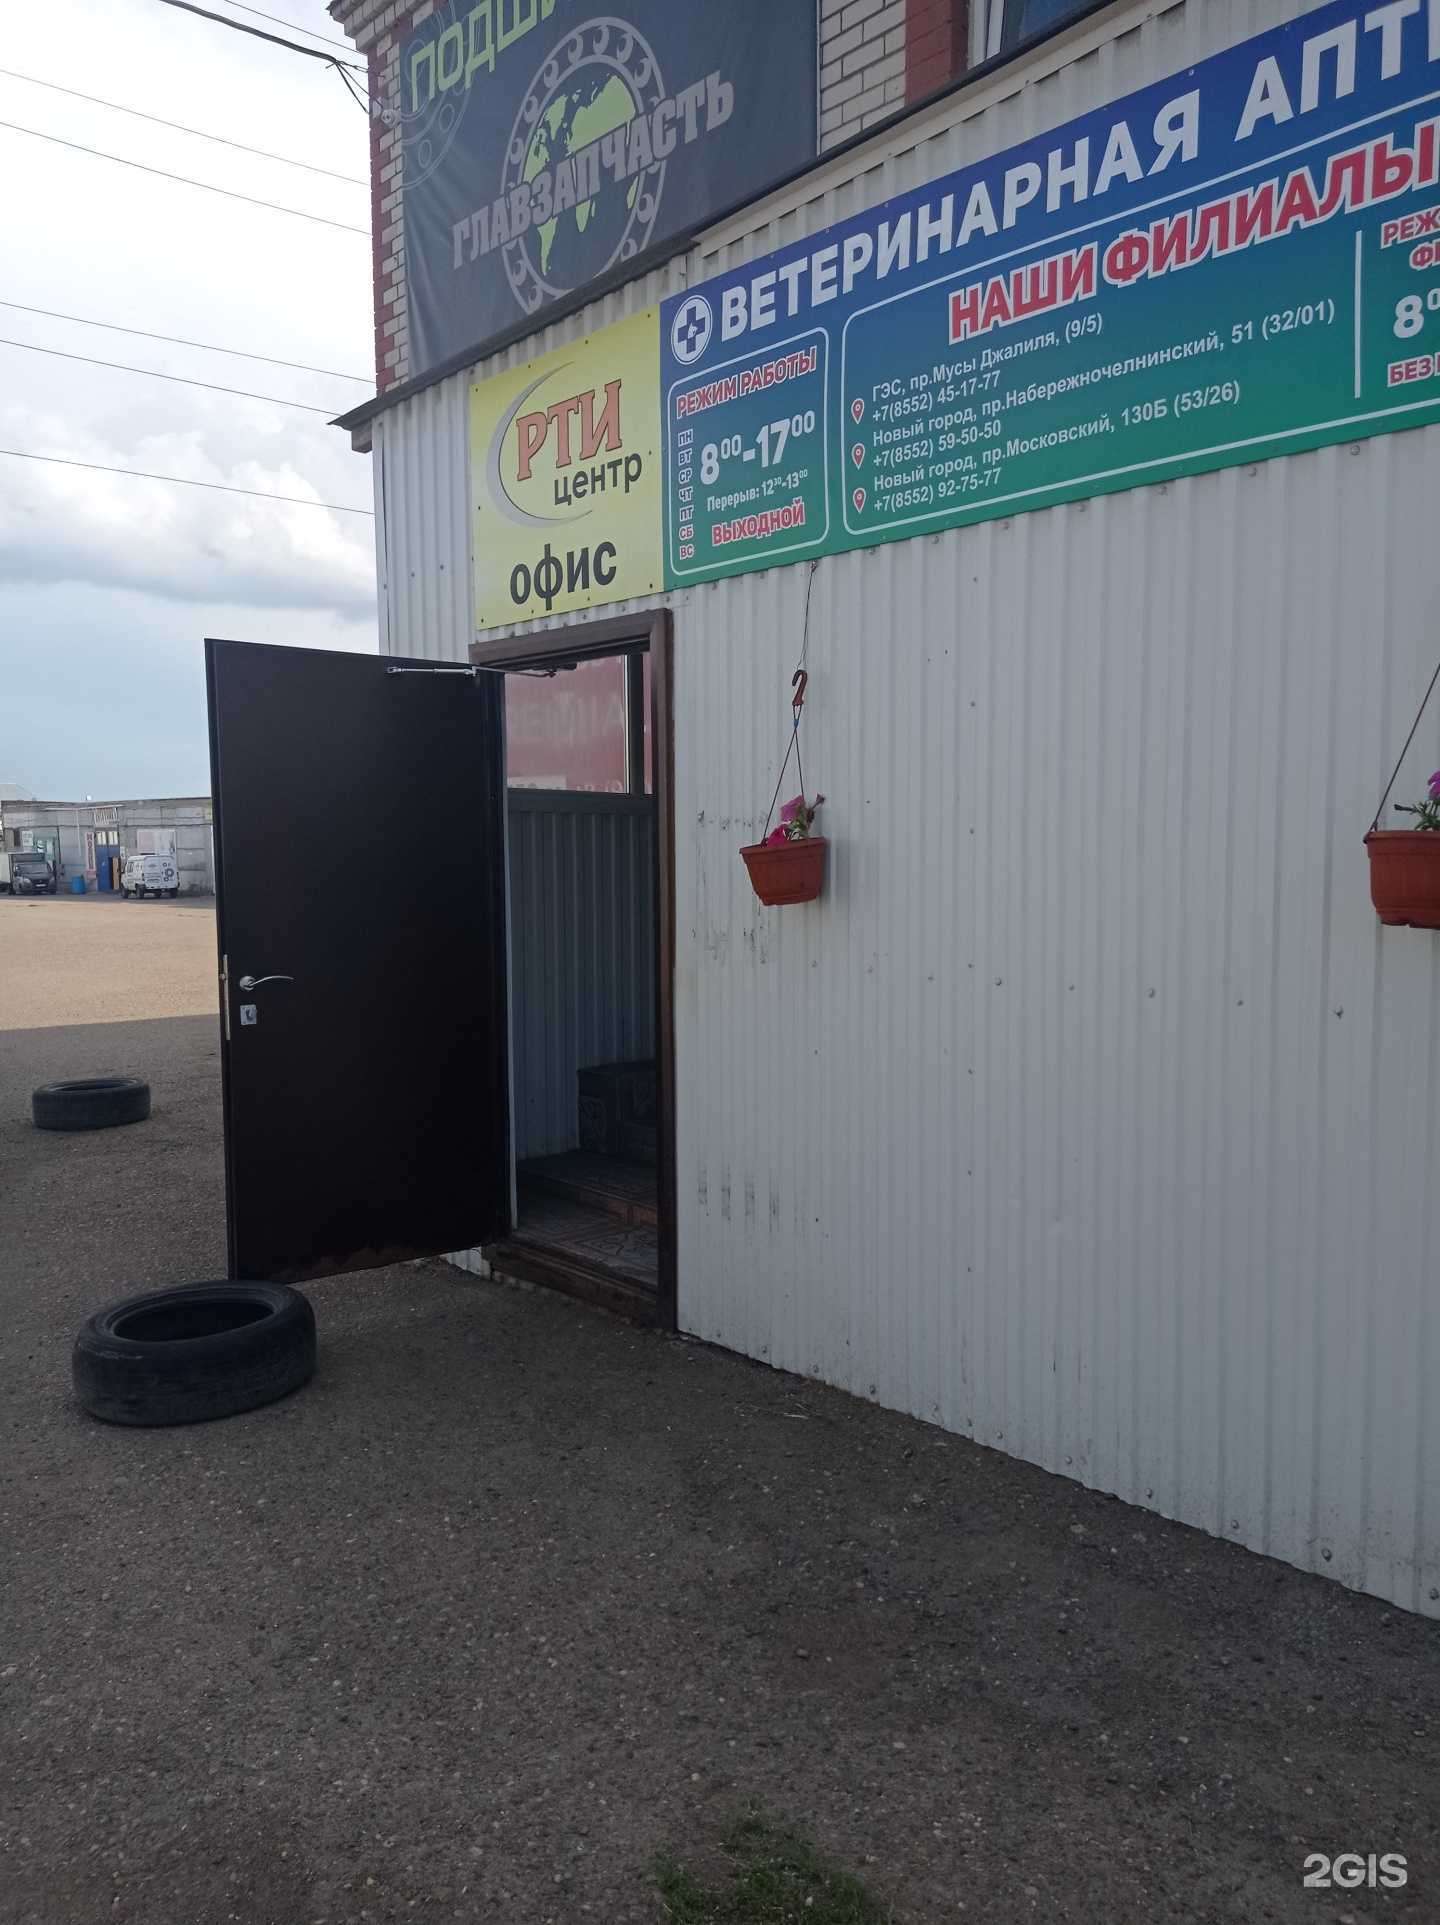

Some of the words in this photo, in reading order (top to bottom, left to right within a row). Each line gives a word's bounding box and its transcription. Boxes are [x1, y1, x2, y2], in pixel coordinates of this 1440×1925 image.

[411, 0, 556, 113] ПОДШ
[450, 69, 735, 269] ГЛАВЗАПЧАСТЬ
[720, 88, 1200, 342] ВЕТЕРИНАРНАЯ
[949, 241, 1098, 345] НАШИ
[1102, 116, 1440, 288] ФИЛИАЛЫ
[676, 375, 738, 419] РЕЖИМ
[741, 346, 817, 395] РАБОТЫ
[872, 379, 905, 402] ГЭС,
[910, 358, 976, 391] пр.Мусы
[980, 330, 1060, 370] Джалиля,
[1065, 312, 1103, 343] (9/5)
[873, 419, 924, 447] Новый
[928, 407, 977, 438] город,
[982, 331, 1224, 417] пр.Набережночелнинский,
[1231, 321, 1253, 344] 51
[1262, 299, 1335, 341] (32/01)
[1387, 355, 1434, 387] БЕЗ
[872, 391, 933, 423] +7(8552)
[937, 370, 1001, 404] 45-17-77
[516, 379, 623, 481] РТИ
[678, 429, 694, 444] ПН
[873, 438, 933, 468] +7(8552)
[938, 420, 1001, 452] 59-50-50
[874, 464, 924, 491] Новый
[928, 455, 977, 483] город,
[982, 414, 1115, 466] пр.Московский,
[1121, 399, 1168, 426] 130Б
[1173, 380, 1240, 417] (53/26)
[554, 453, 642, 505] центр
[678, 449, 693, 465] ВТ
[678, 467, 693, 484] СР
[678, 486, 693, 502] ЧТ
[679, 506, 694, 521] ПТ
[707, 487, 760, 512] Перерыв:
[874, 484, 934, 513] +7(8552)
[938, 467, 1001, 498] 92-75-77
[679, 524, 694, 540] СБ
[712, 496, 806, 547] ВЫХОДНОЙ
[510, 541, 617, 611] офис
[679, 545, 695, 560] ВС
